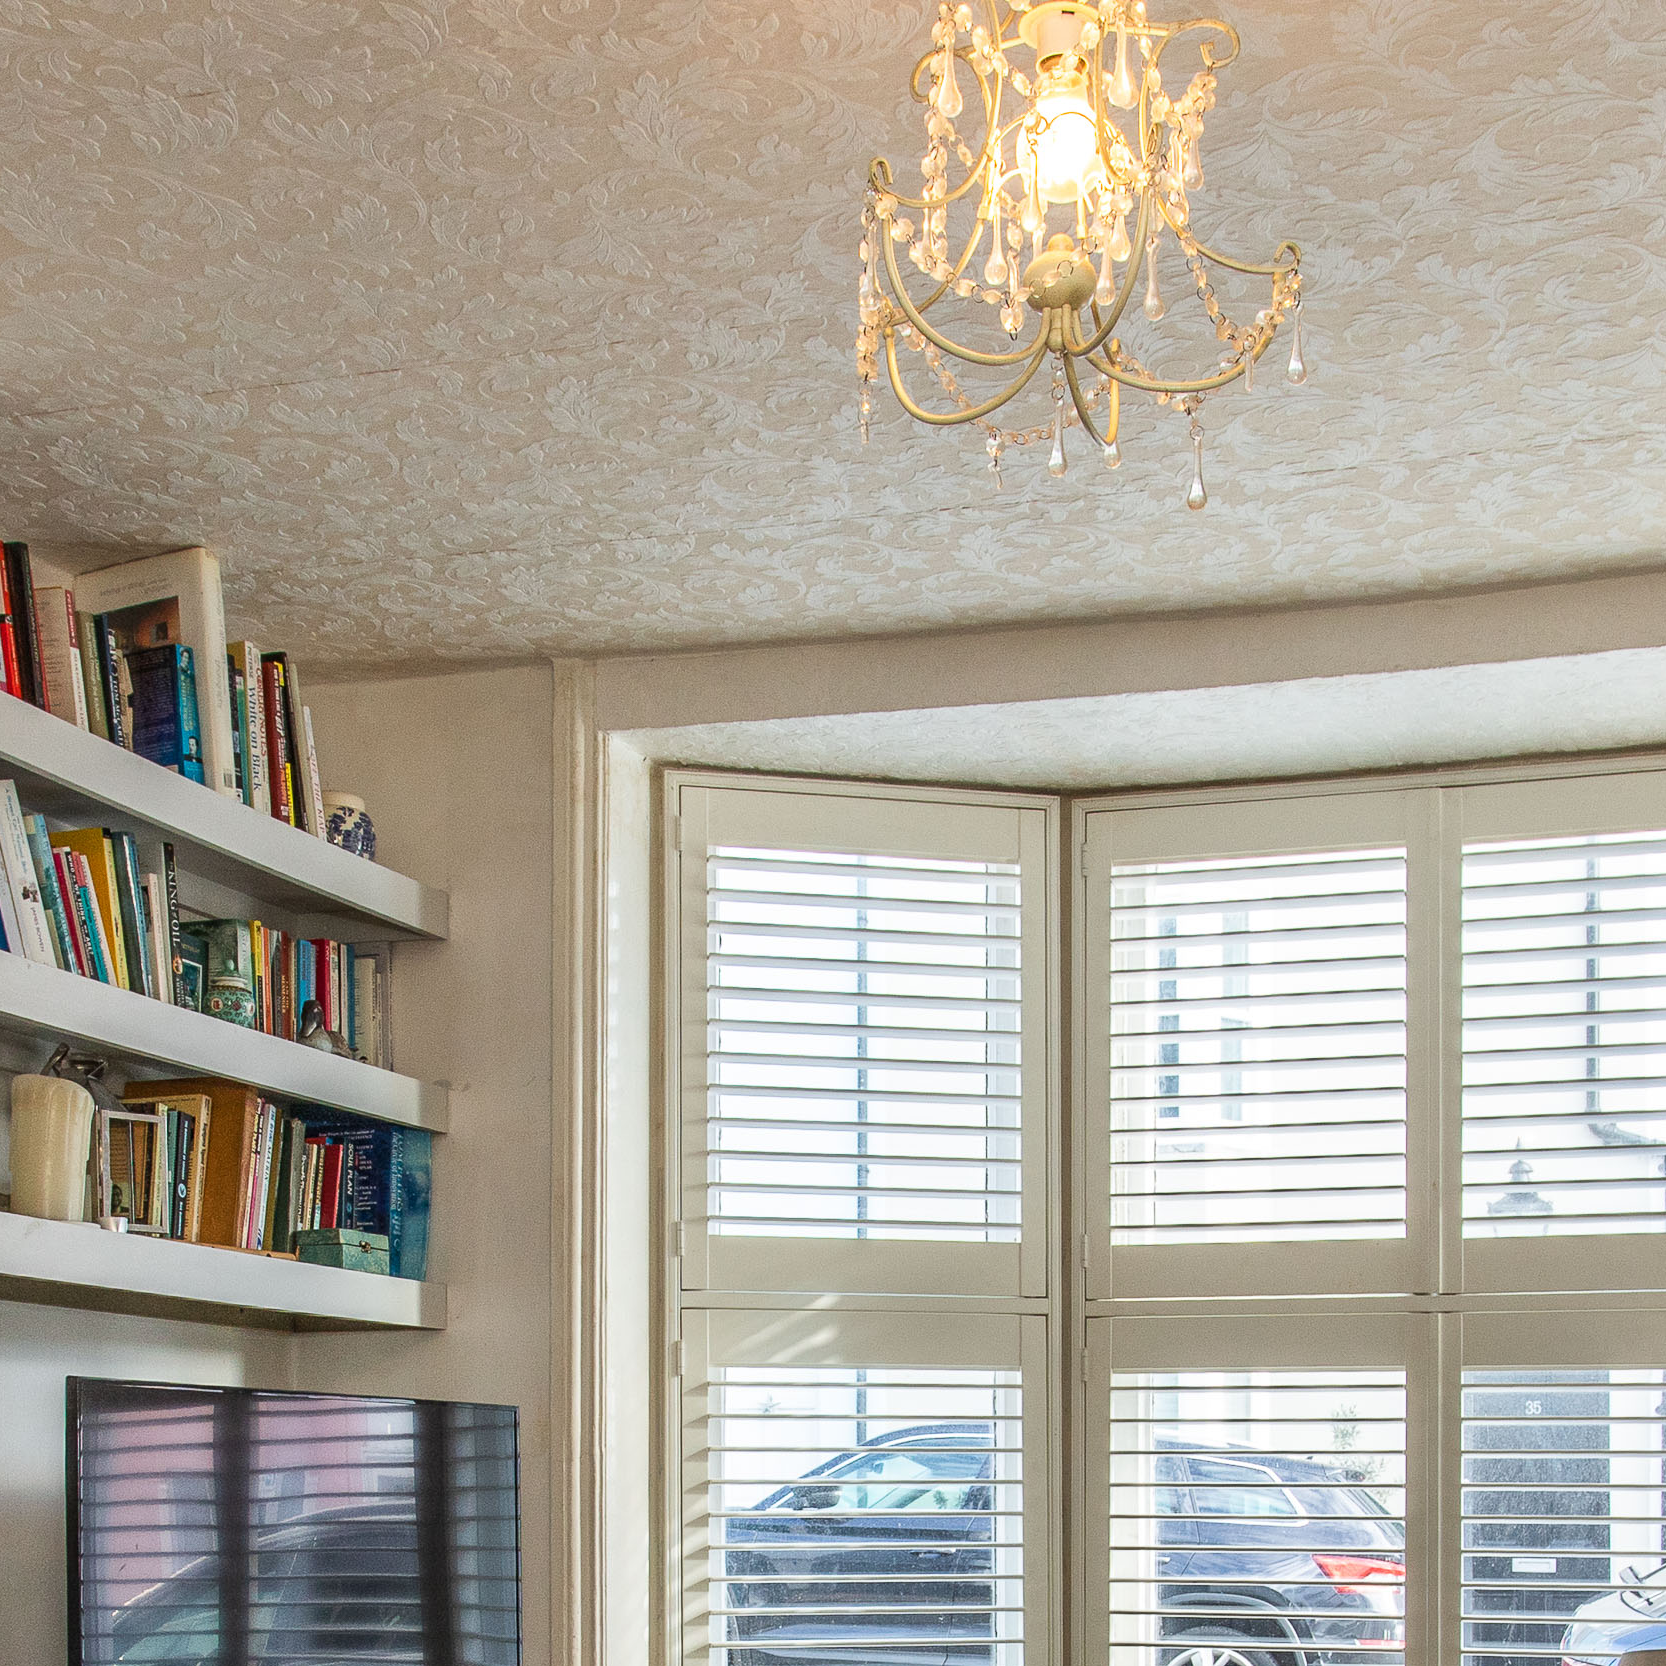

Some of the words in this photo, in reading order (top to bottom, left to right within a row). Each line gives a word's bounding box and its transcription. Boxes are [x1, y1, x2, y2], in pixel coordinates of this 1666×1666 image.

[112, 679, 120, 702] TOM
[255, 666, 265, 714] COOKERY
[247, 686, 258, 727] White
[114, 703, 124, 746] McCART
[258, 716, 268, 758] NOTES
[250, 729, 258, 750] on
[252, 752, 263, 791] Black
[4, 794, 16, 818] Street
[13, 832, 27, 860] Named
[316, 806, 326, 834] MAP
[66, 854, 75, 873] WHO
[166, 870, 178, 911] KING
[28, 906, 40, 928] JAMES
[33, 926, 46, 954] BOWEN
[170, 918, 181, 947] OIL
[263, 1144, 272, 1181] MATRIX
[346, 1143, 354, 1168] SOUL
[345, 1169, 354, 1195] PLAN
[1525, 1399, 1542, 1414] 35
